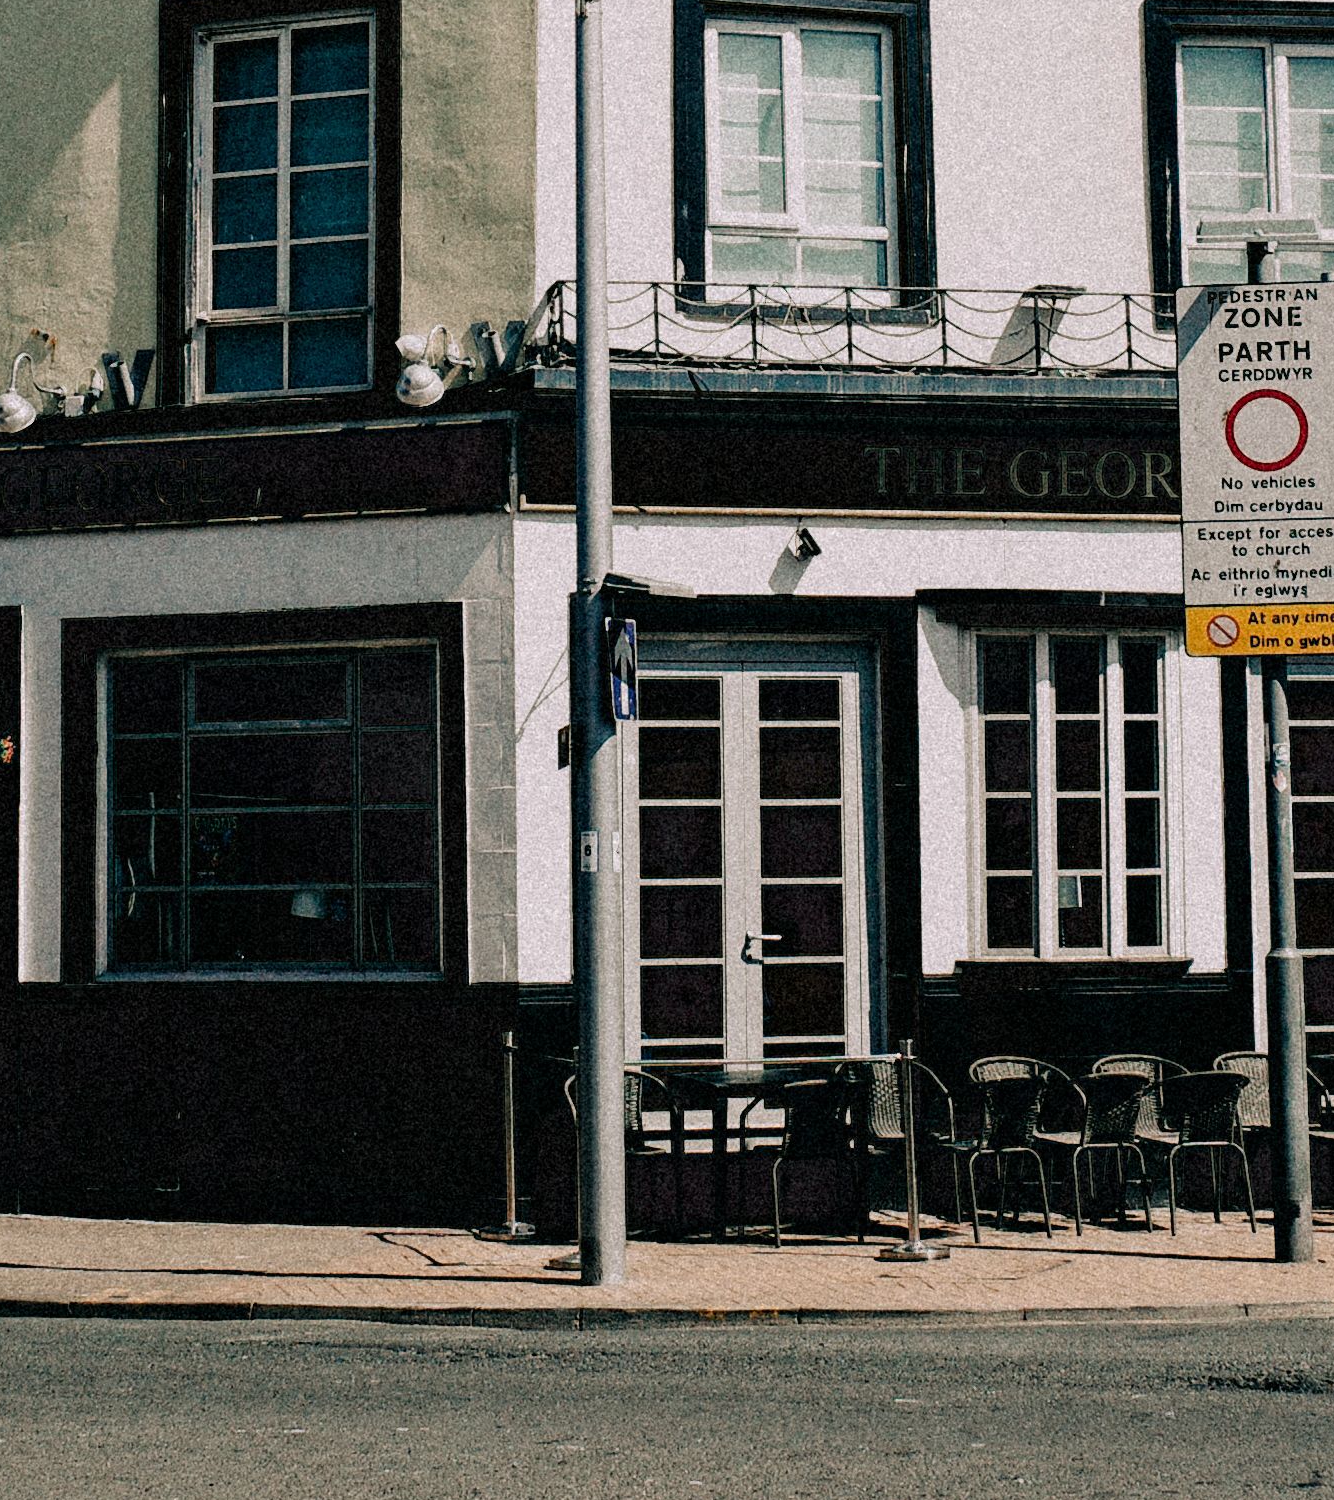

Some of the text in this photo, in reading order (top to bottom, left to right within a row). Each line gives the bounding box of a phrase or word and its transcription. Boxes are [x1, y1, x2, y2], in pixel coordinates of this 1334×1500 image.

[1224, 306, 1302, 329] ZONE
[1218, 339, 1311, 363] PARTH
[1218, 367, 1313, 383] CERDDWYR
[863, 446, 1180, 499] THE GEOR
[1221, 475, 1316, 490] No vehicles
[1214, 499, 1323, 514] Dim cerbydau
[1197, 527, 1252, 543] Except
[1259, 526, 1281, 539] for
[1232, 543, 1311, 557] to church
[1191, 568, 1211, 581] Ac
[1218, 567, 1270, 581] eithrio
[1255, 583, 1308, 599] eglwys
[1248, 611, 1266, 625] At
[1271, 613, 1299, 626] any
[1249, 635, 1280, 648] Dim
[1284, 637, 1294, 647] o
[584, 844, 592, 857] 6
